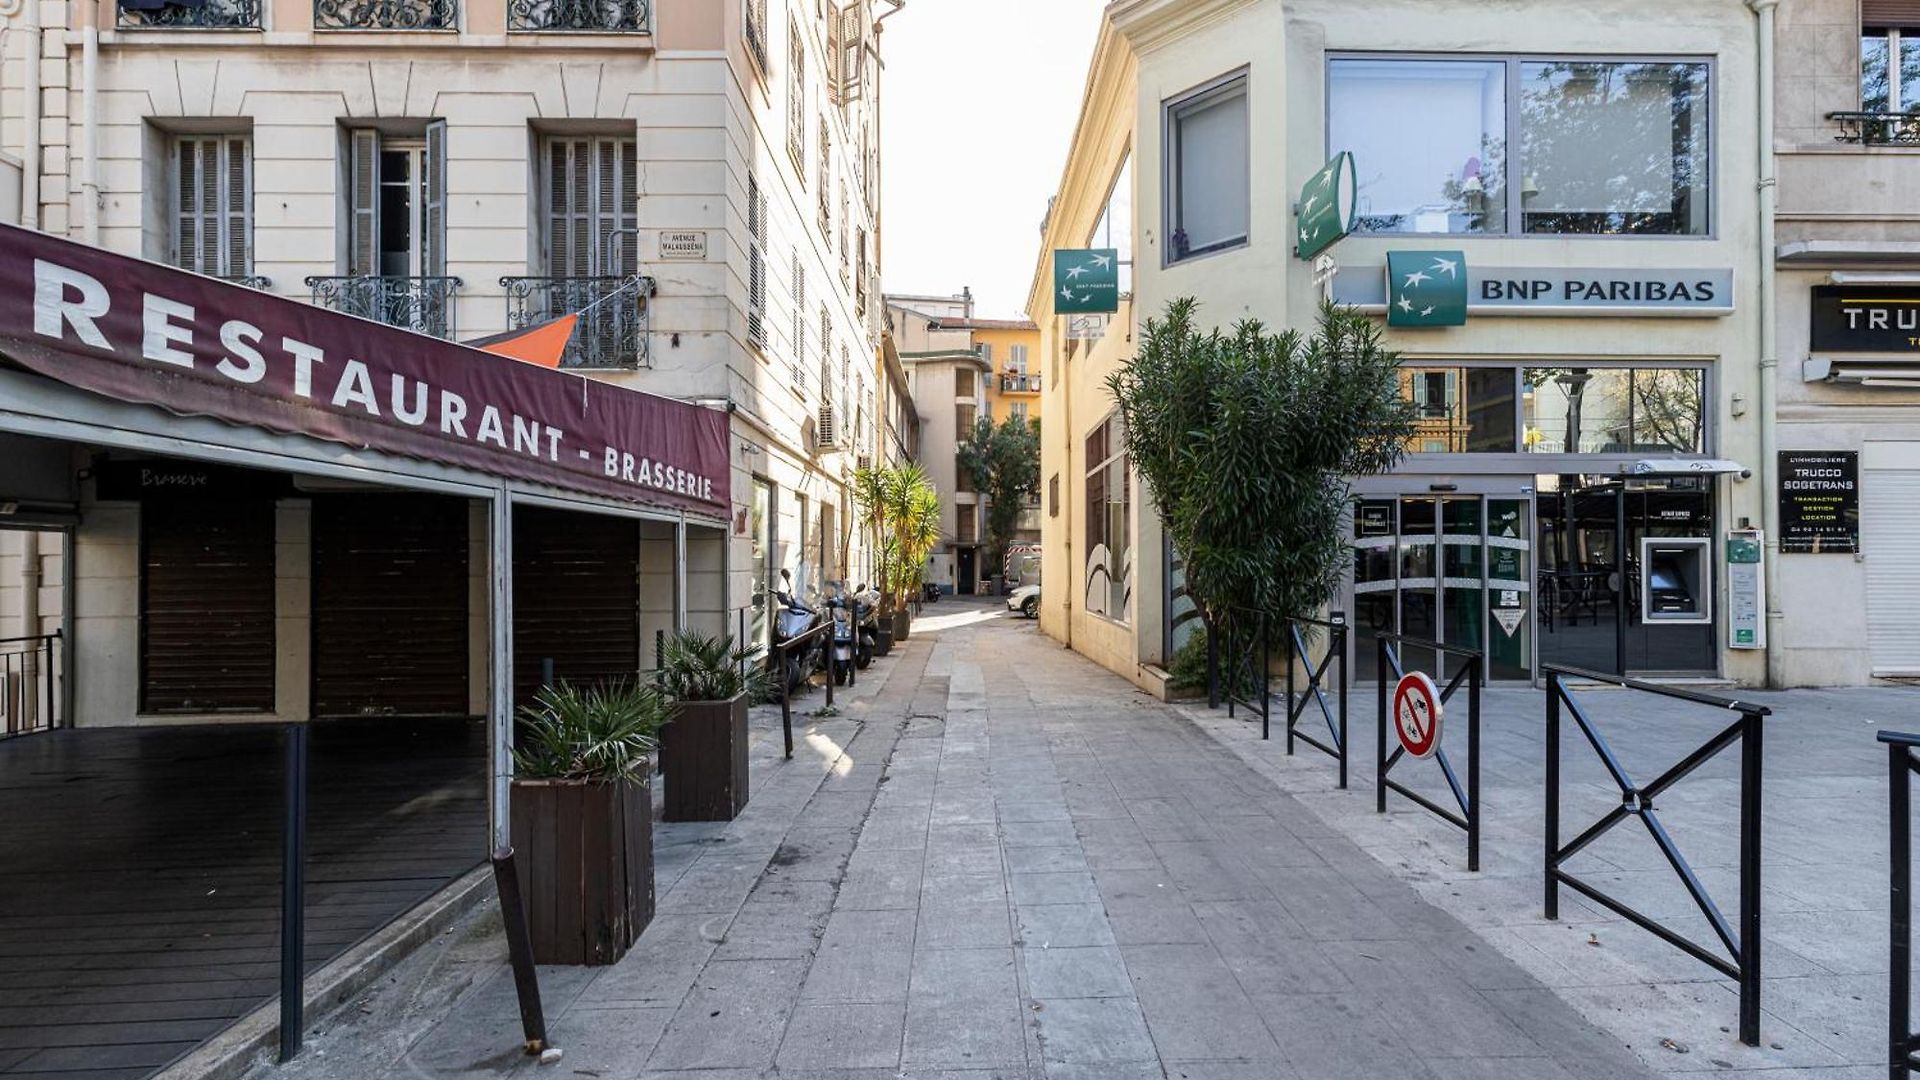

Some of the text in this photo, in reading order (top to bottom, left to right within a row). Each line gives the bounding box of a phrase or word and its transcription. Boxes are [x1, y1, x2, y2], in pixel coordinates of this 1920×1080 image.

[672, 234, 696, 242] AVENUE
[1481, 279, 1715, 302] BNP PARIBAS
[34, 258, 563, 462] RESTAURANT
[604, 446, 713, 500] BRASSERIE
[1794, 468, 1842, 477] TRUCCO
[1783, 480, 1854, 490] SOGETRANS
